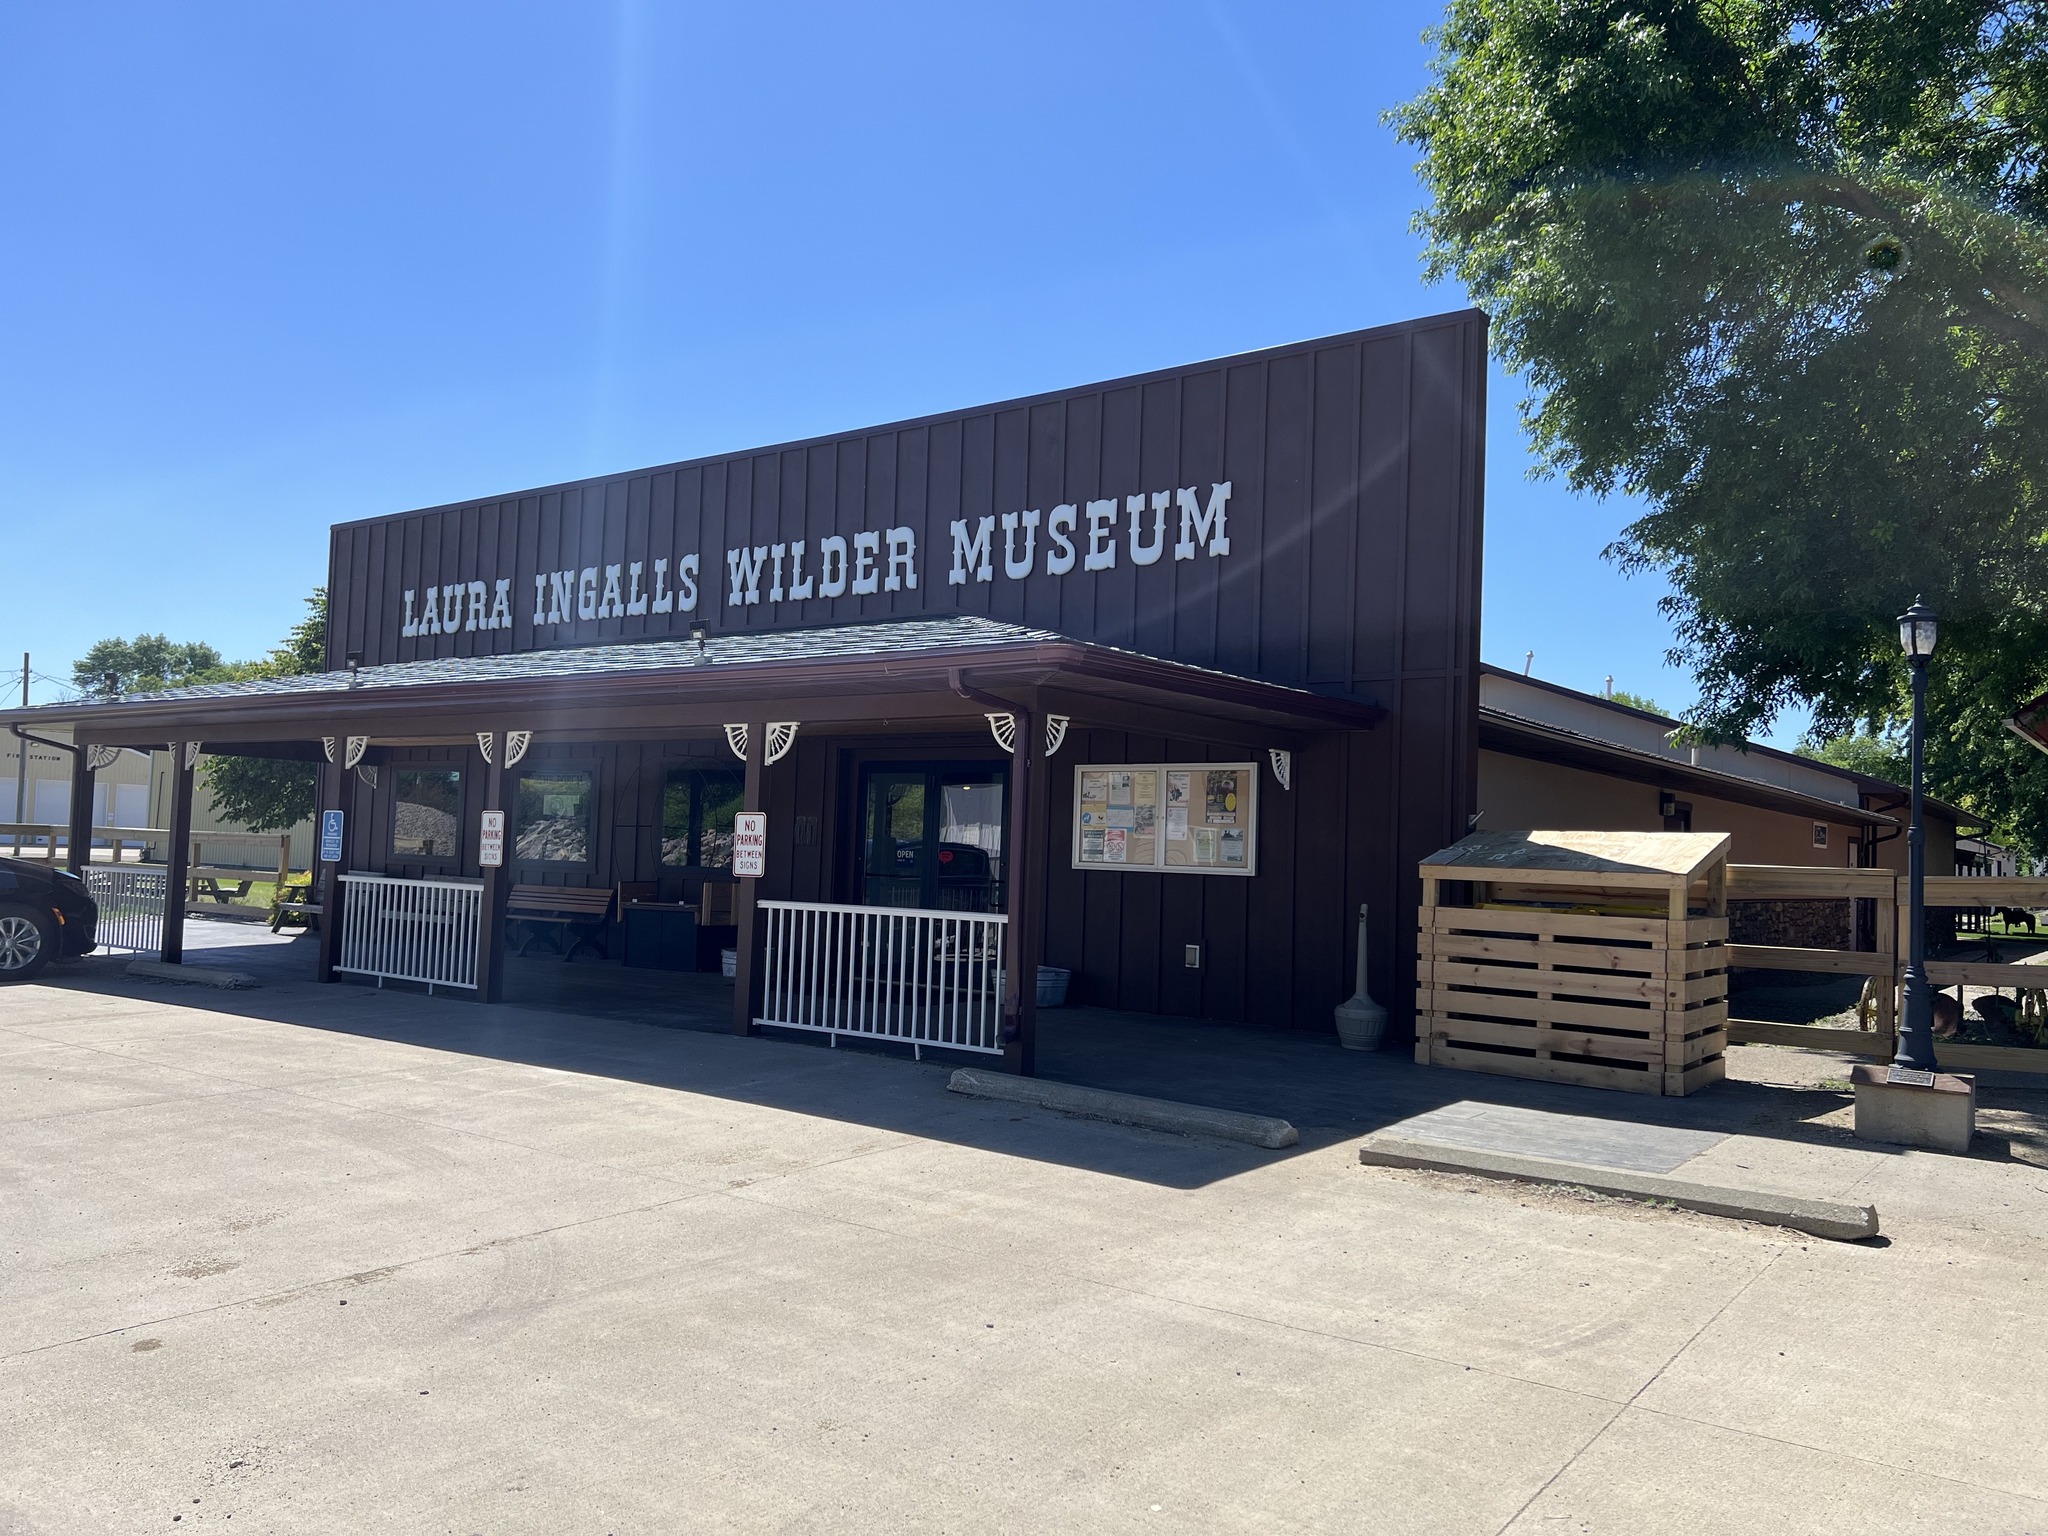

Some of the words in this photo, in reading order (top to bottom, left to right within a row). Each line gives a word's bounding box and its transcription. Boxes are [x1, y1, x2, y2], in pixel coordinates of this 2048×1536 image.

[402, 578, 512, 637] LAURA
[533, 553, 700, 626] INGALLS
[727, 525, 917, 606] WILDER
[948, 480, 1232, 586] MUSEUM
[488, 817, 497, 828] NO
[744, 820, 756, 832] NO
[482, 830, 501, 840] PARKING
[736, 834, 763, 846] PARKING
[736, 850, 762, 859] BETWEEN
[896, 850, 914, 858] OPEN
[740, 861, 758, 870] SIGNS
